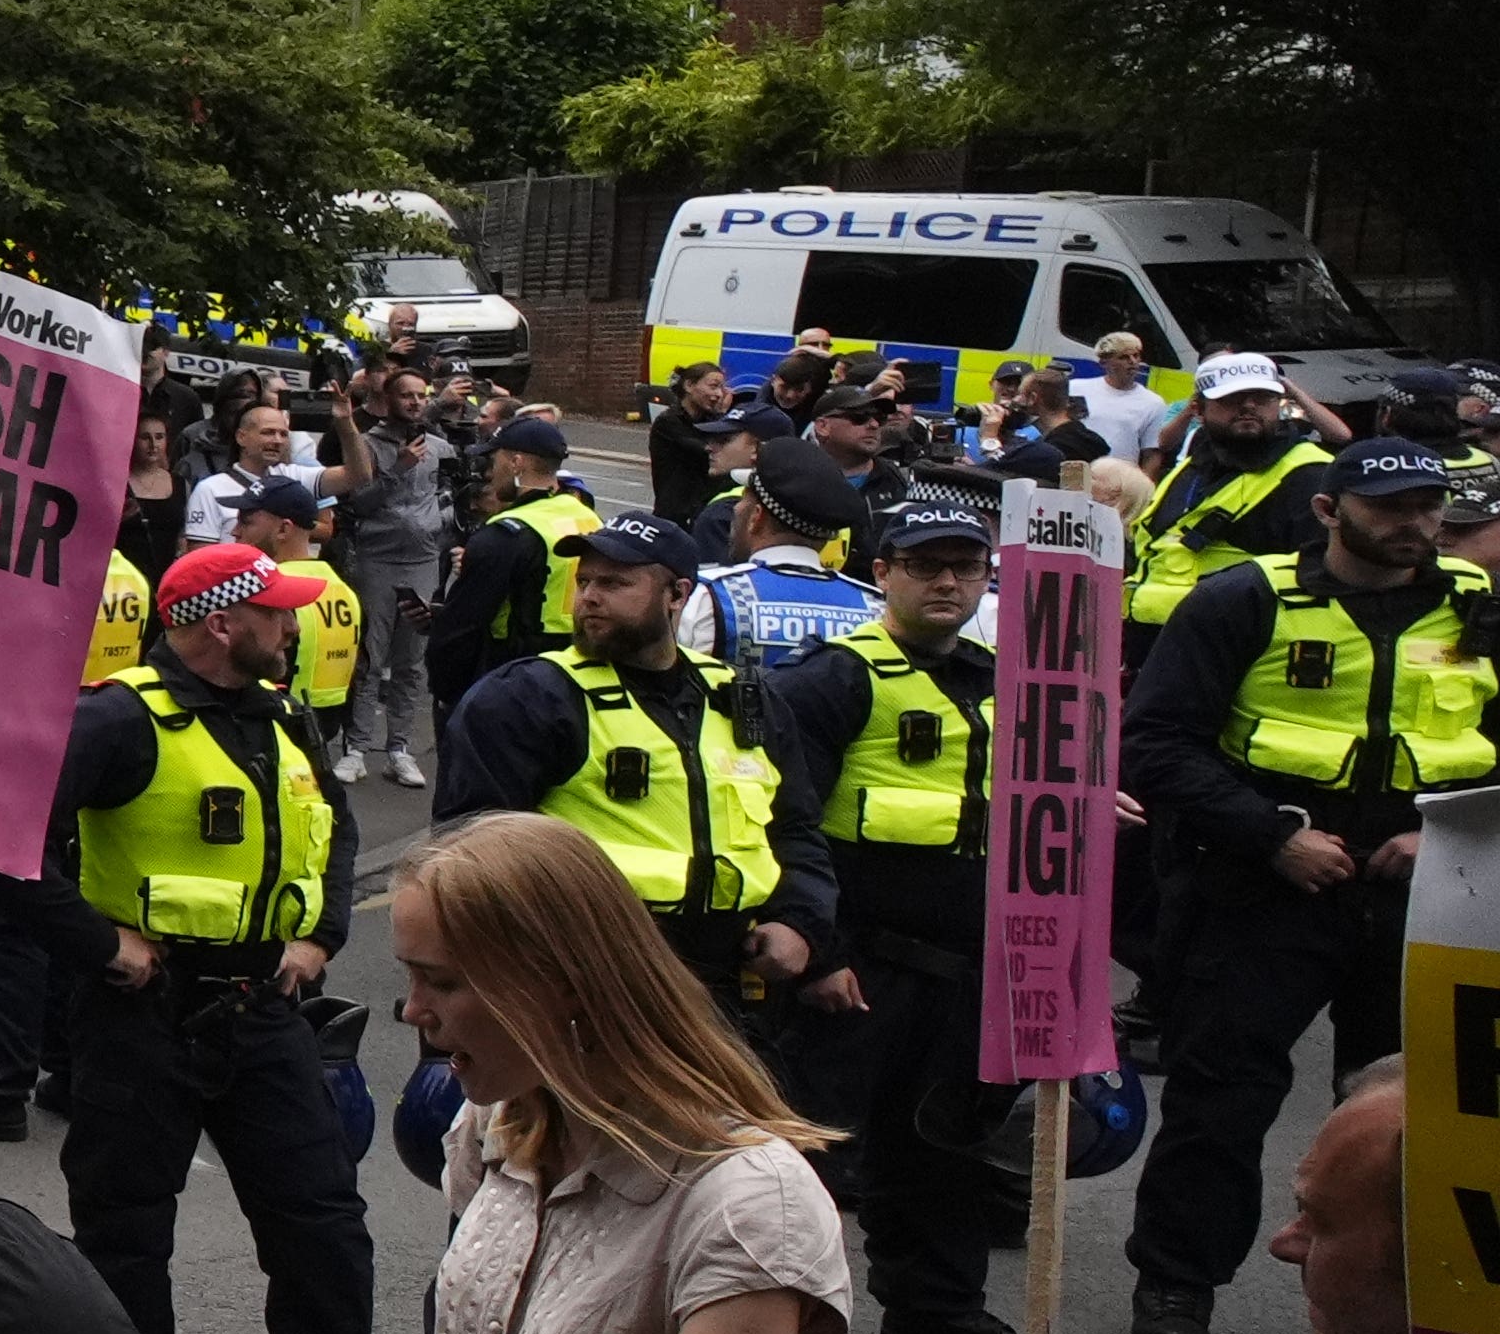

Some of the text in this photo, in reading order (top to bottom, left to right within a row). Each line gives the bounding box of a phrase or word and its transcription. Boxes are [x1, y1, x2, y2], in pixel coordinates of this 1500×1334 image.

[717, 208, 1044, 243] POLICE
[1219, 365, 1268, 379] POLICE
[1362, 456, 1446, 476] POLICE
[606, 517, 659, 543] LICE
[905, 510, 982, 527] POLICE
[101, 592, 139, 623] VG
[315, 599, 353, 629] VG
[759, 606, 875, 622] METROPOLITAN
[760, 616, 857, 641] POLIC
